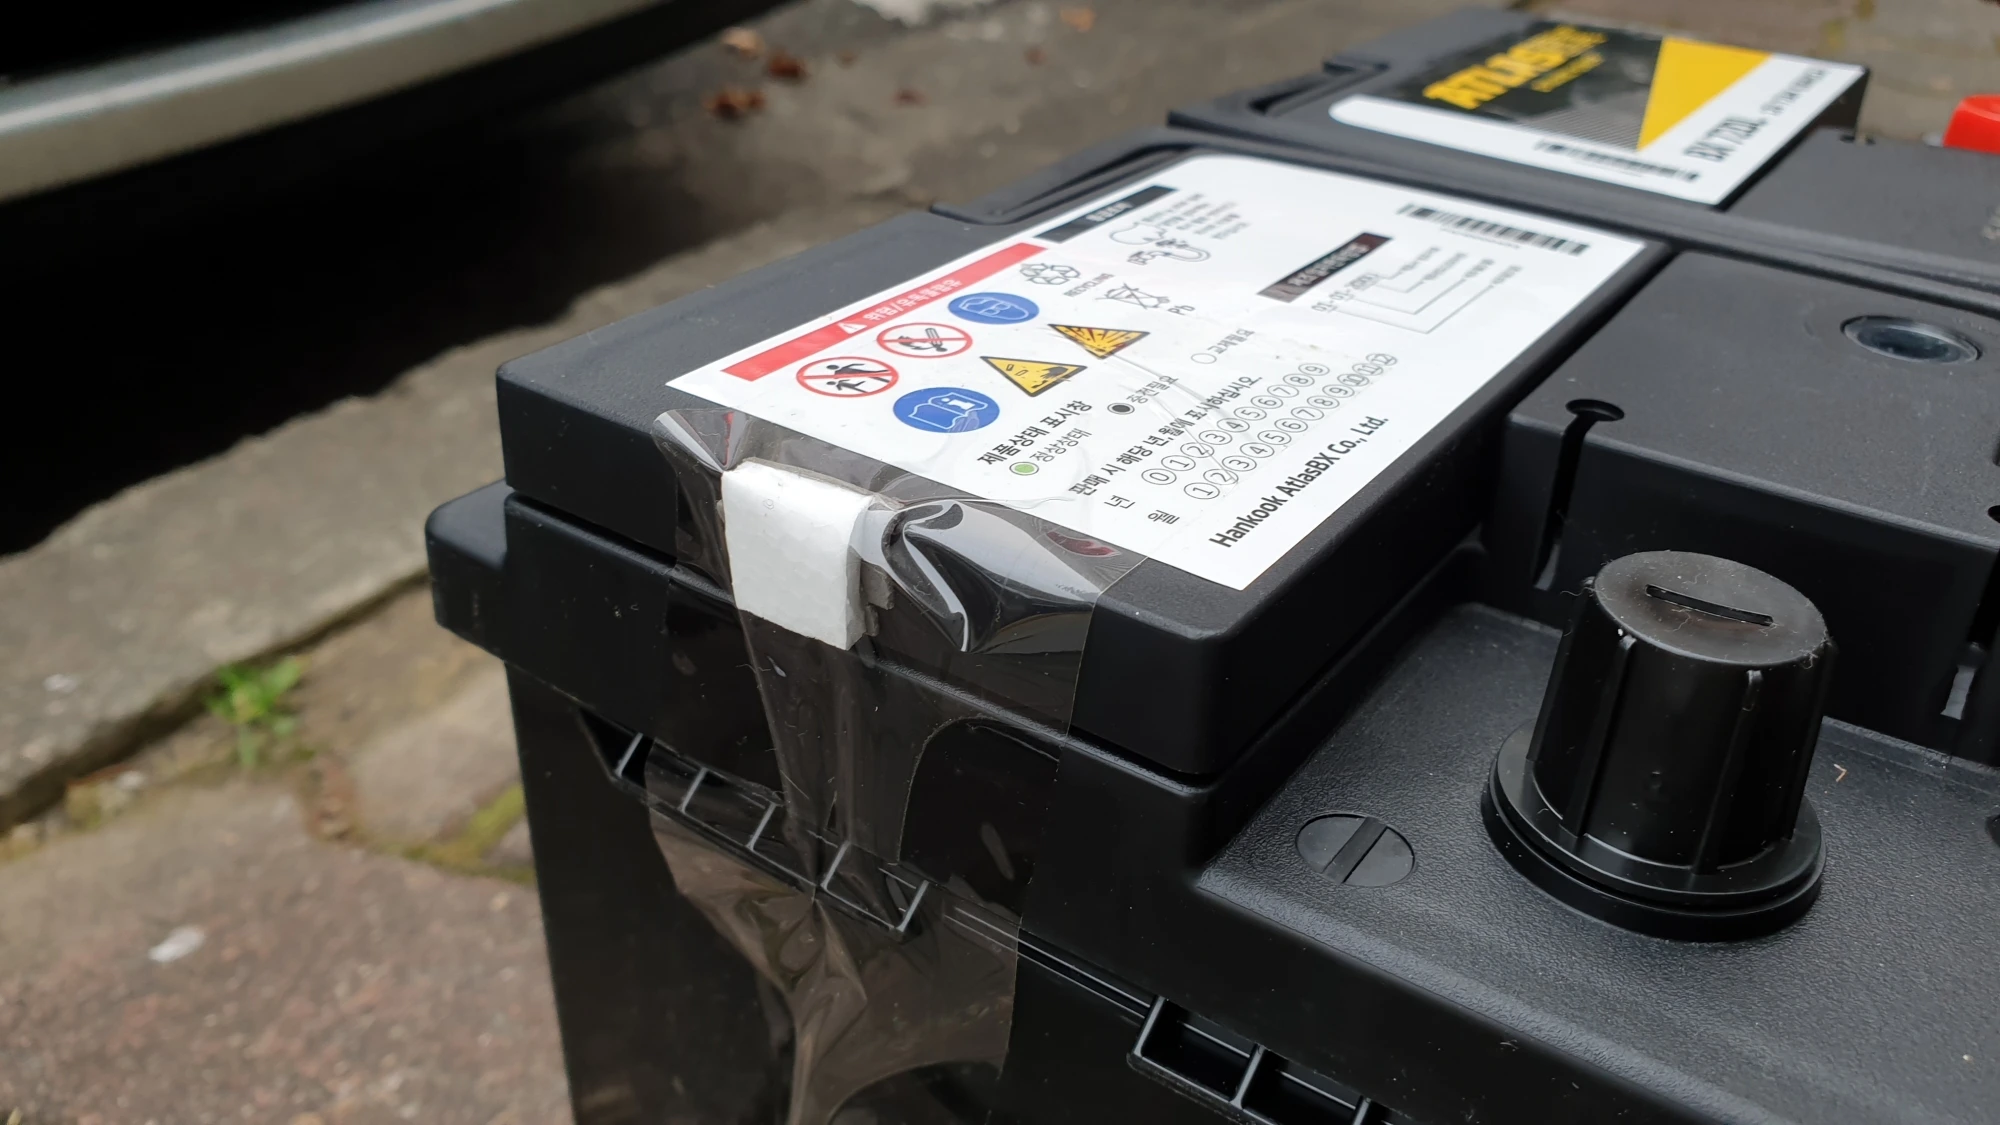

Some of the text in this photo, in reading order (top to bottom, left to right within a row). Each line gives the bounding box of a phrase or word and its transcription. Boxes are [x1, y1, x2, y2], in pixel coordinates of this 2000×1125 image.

[1166, 304, 1196, 316] Pb
[976, 400, 1093, 465] 제품상태 표시창
[1029, 427, 1093, 463] 정상상태
[1068, 474, 1111, 496] 판매
[1100, 463, 1127, 476] 시
[1115, 445, 1153, 465] 해당
[1208, 415, 1389, 548] Hankook AtlasBX Co., Ltd.
[1103, 494, 1136, 509] 년
[1147, 509, 1180, 525] 월
